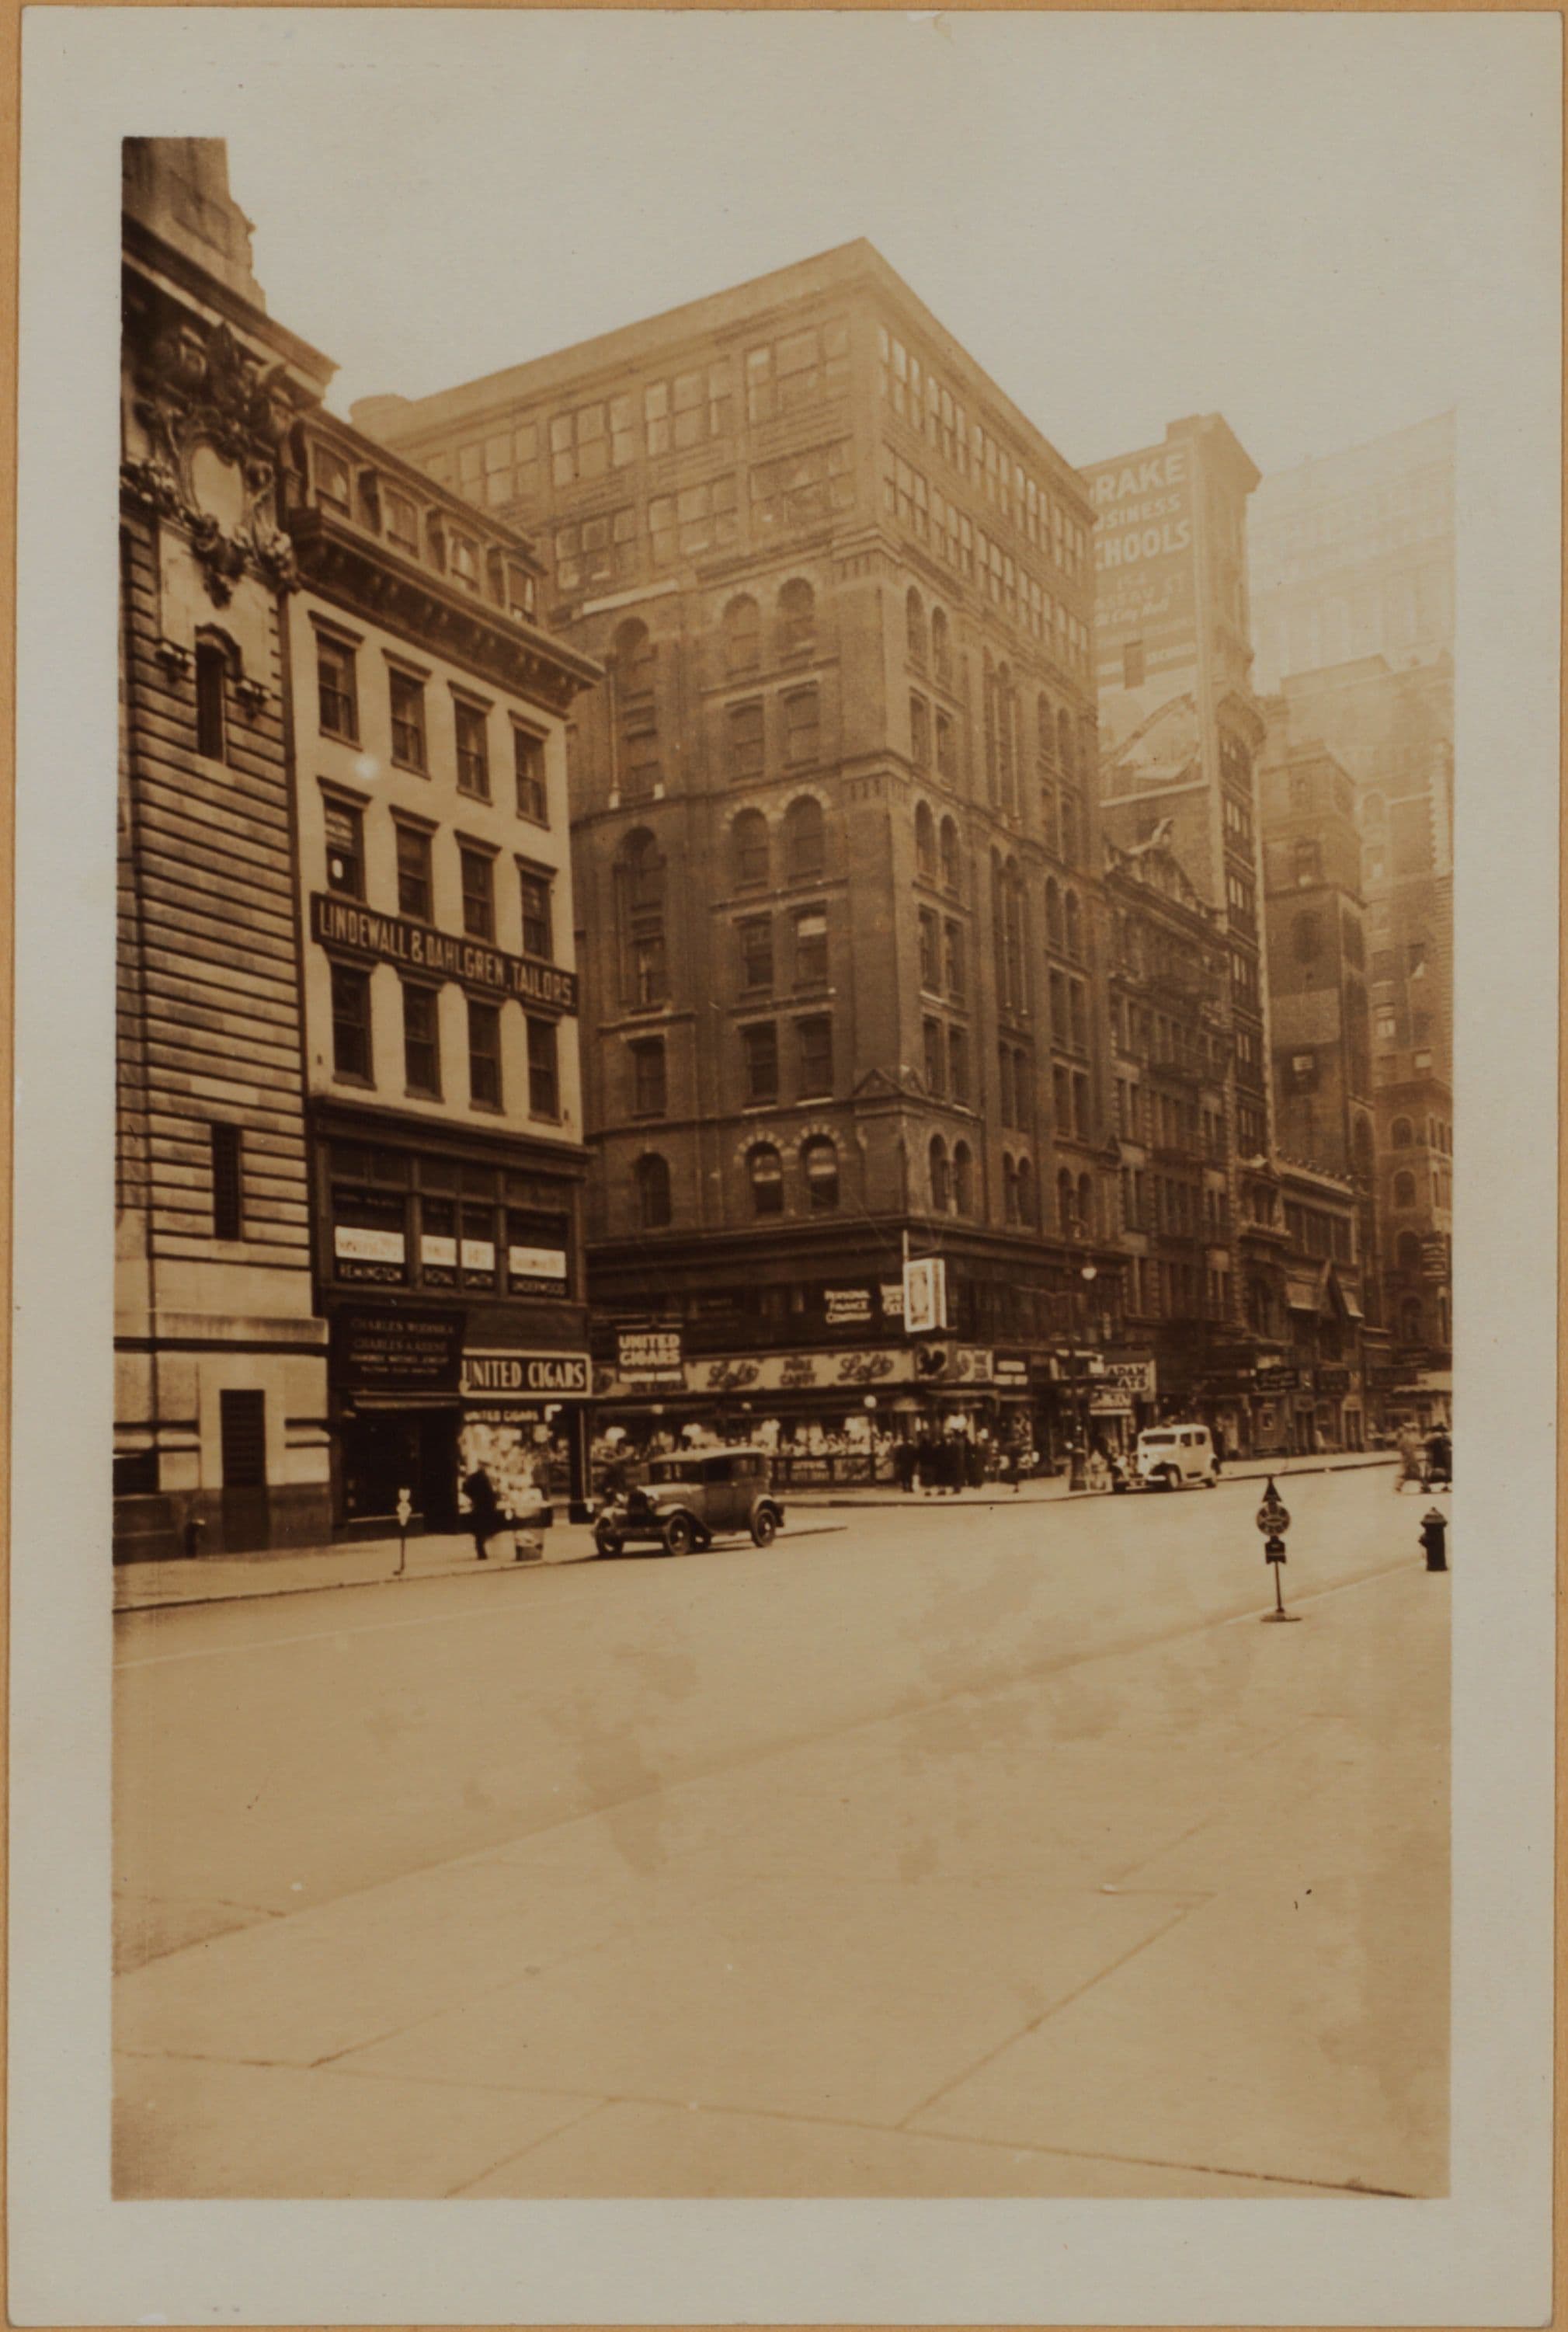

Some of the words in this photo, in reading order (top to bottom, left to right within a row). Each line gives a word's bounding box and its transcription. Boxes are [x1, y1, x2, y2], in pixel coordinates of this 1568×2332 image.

[1088, 453, 1187, 505] RAKE
[318, 899, 409, 959] LINDEWALL
[410, 930, 424, 963] &
[509, 961, 572, 1006] TAILORS
[620, 1334, 680, 1349] UNITED
[620, 1349, 680, 1366] CIGARS
[462, 1359, 522, 1388] UNITED
[527, 1361, 586, 1389] CIGARS
[1108, 1366, 1146, 1377] ADAM
